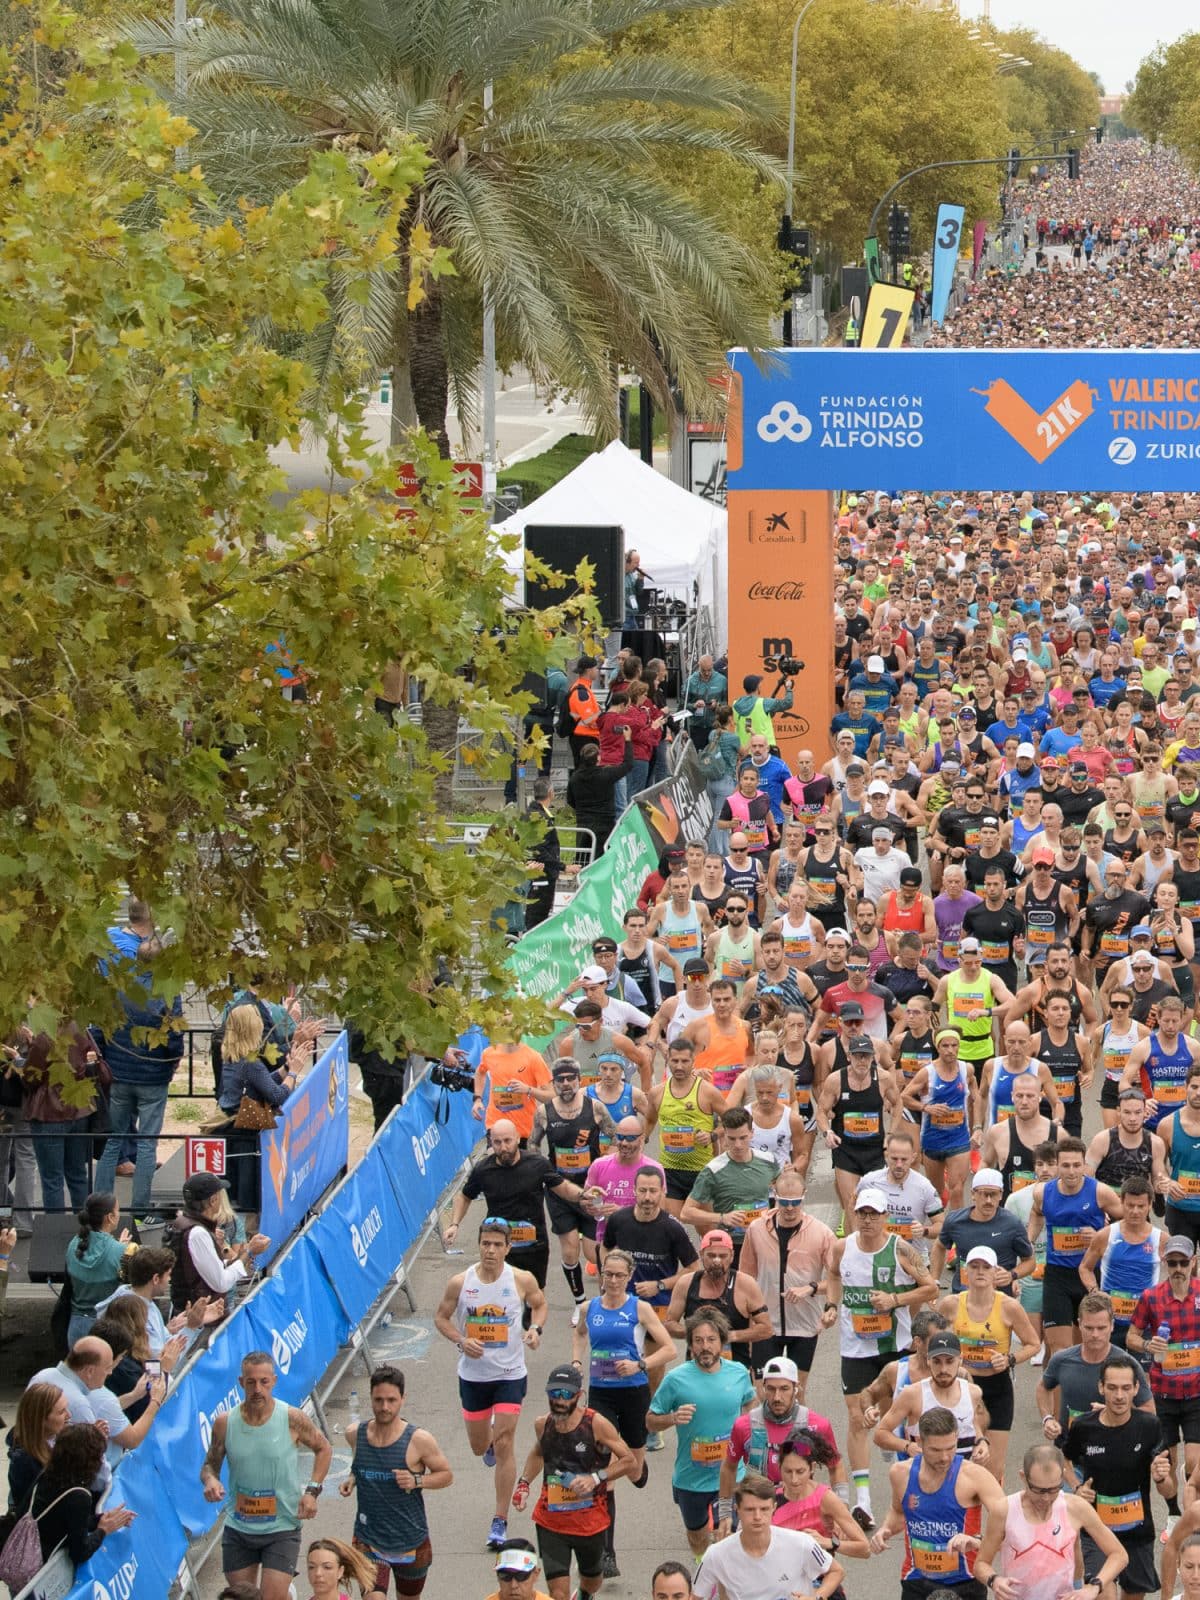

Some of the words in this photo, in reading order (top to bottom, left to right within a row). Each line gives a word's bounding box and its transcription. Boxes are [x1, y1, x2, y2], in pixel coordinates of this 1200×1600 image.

[938, 218, 960, 250] 3
[876, 308, 903, 348] 1
[820, 394, 923, 408] FUNDACIÓN
[820, 412, 924, 430] TRINIDAD
[1036, 396, 1083, 449] 21K
[820, 431, 924, 448] ALFONSO
[758, 534, 797, 544] CaixaBank
[748, 581, 804, 600] Coca-Cola
[884, 1204, 913, 1213] ELLAR
[361, 1205, 384, 1248] ZURICH
